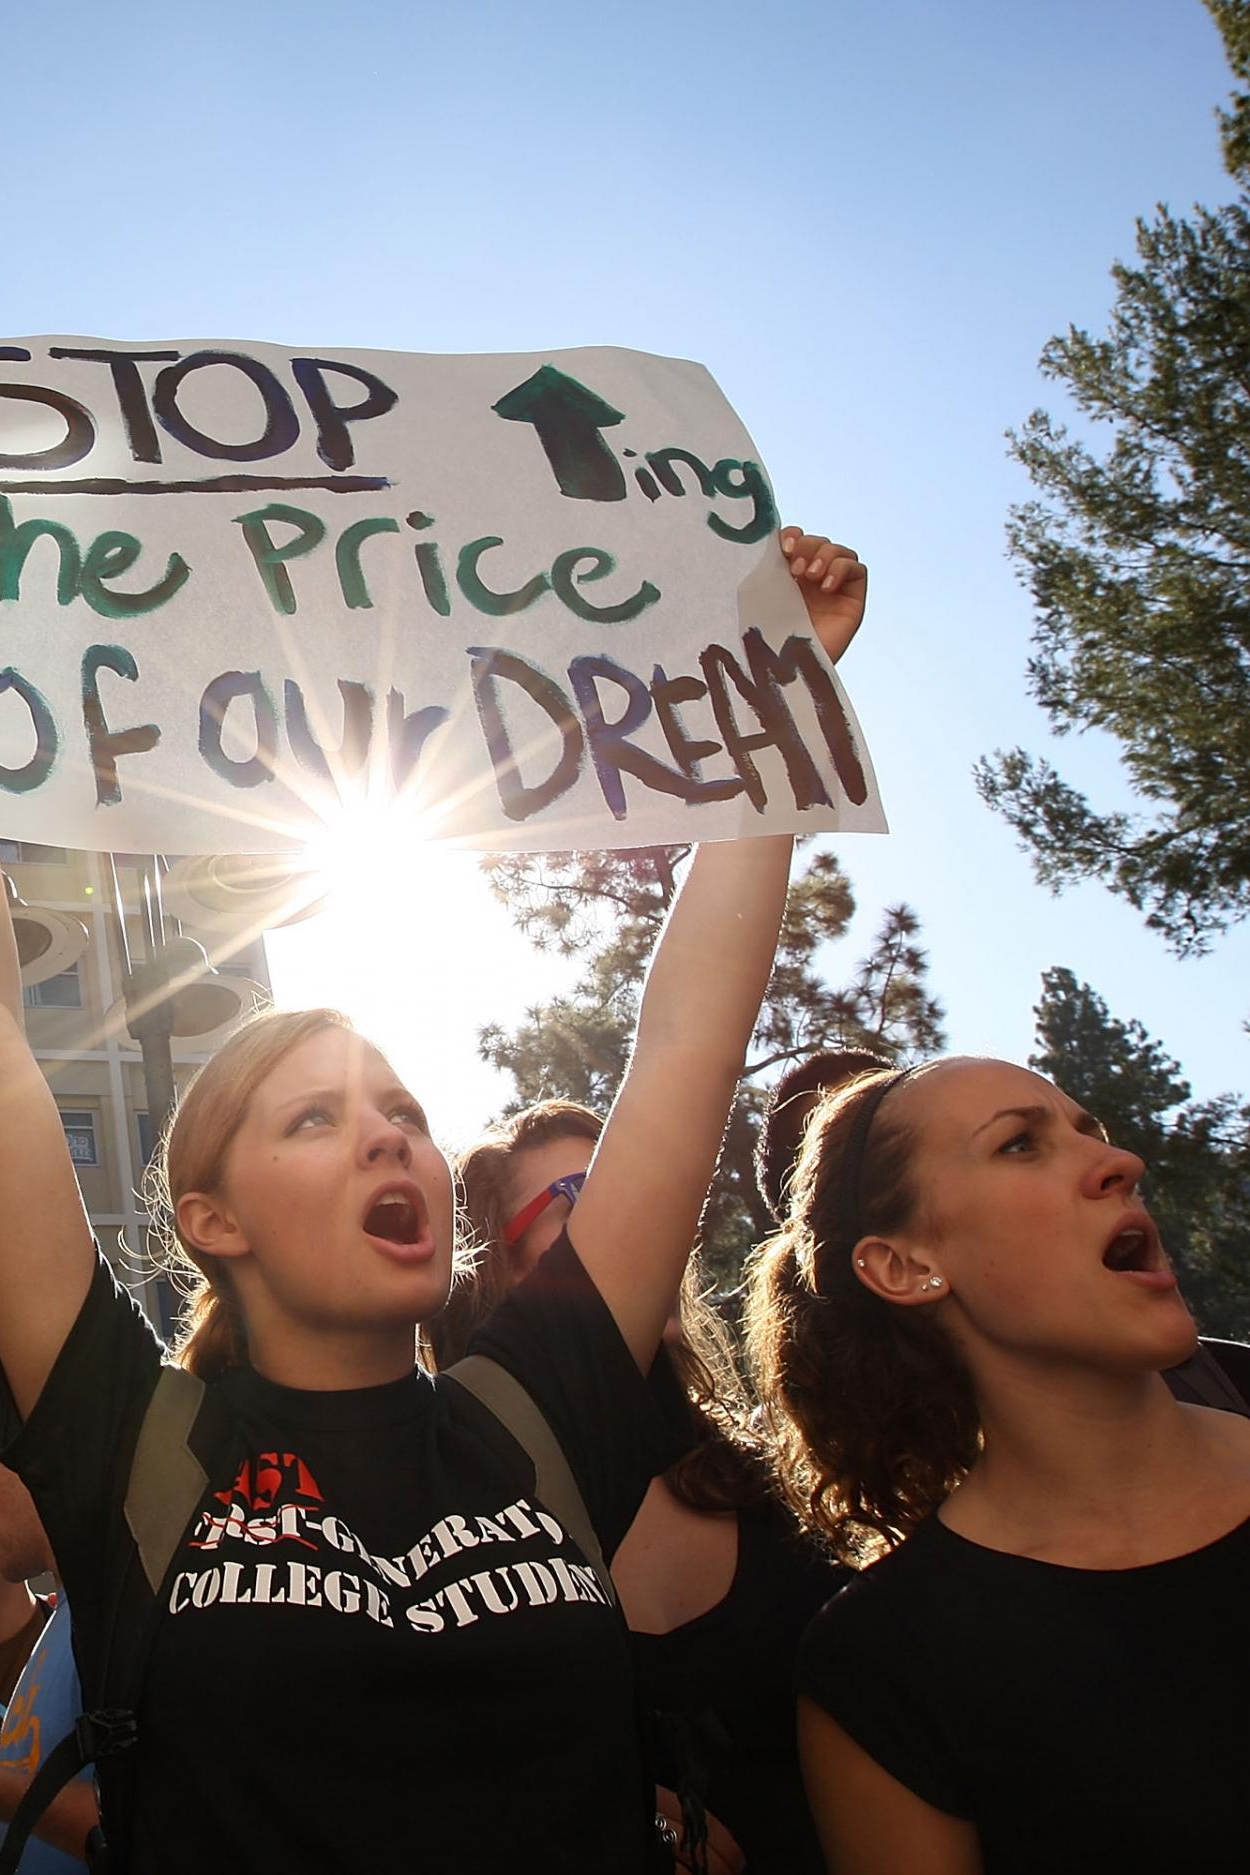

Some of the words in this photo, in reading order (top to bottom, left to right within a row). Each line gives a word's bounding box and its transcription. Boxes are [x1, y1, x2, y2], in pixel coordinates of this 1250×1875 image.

[623, 447, 781, 544] ing
[465, 627, 868, 820] DREAM
[169, 1561, 395, 1629] COLLEGE
